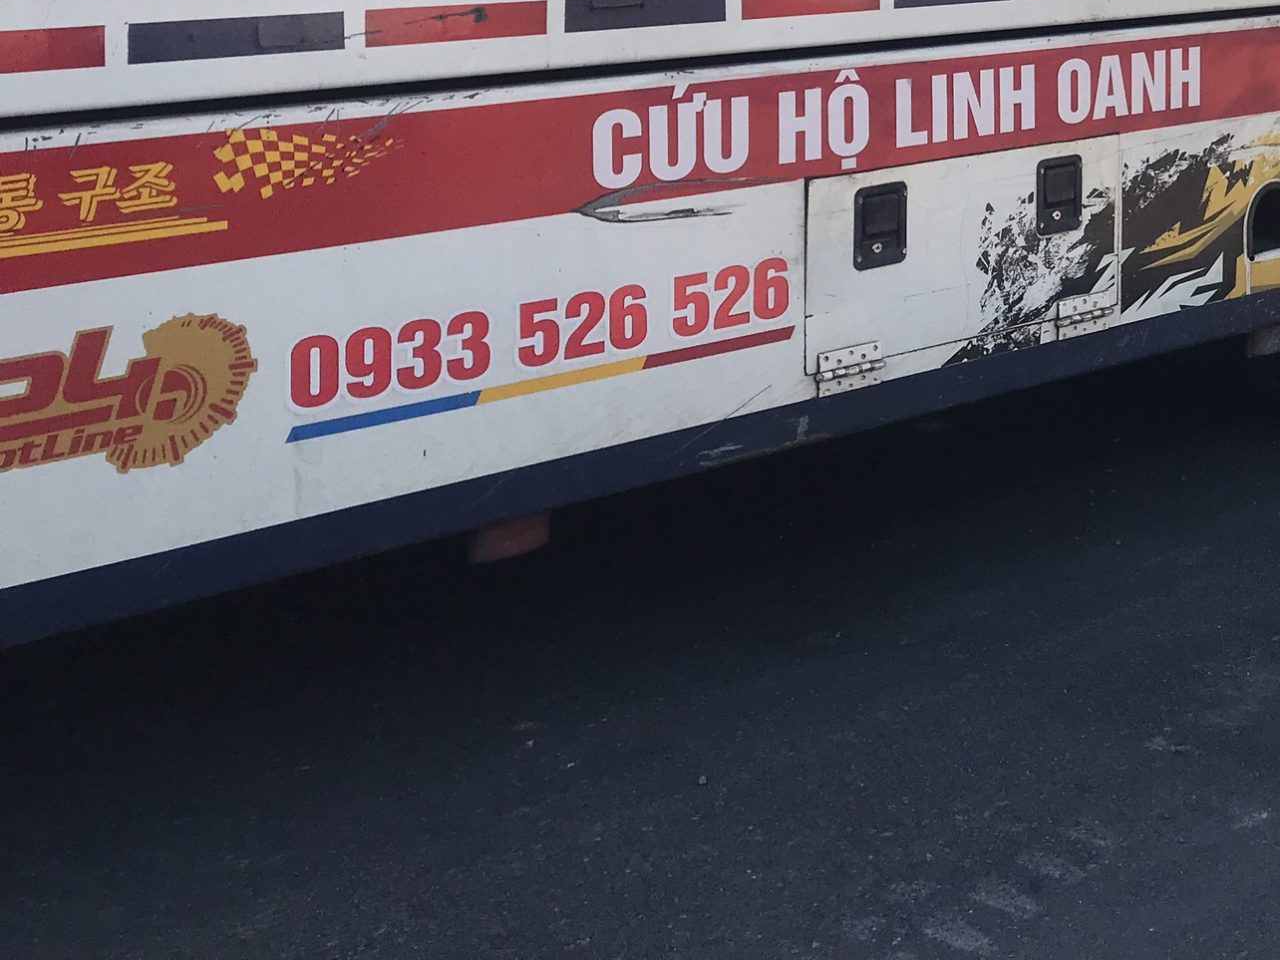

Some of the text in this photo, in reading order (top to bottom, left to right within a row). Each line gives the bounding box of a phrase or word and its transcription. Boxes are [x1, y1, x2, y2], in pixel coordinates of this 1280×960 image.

[592, 46, 1201, 189] CỨU HỘ LINH OANH
[58, 161, 178, 222] 구조
[290, 257, 789, 408] 0933 526 526
